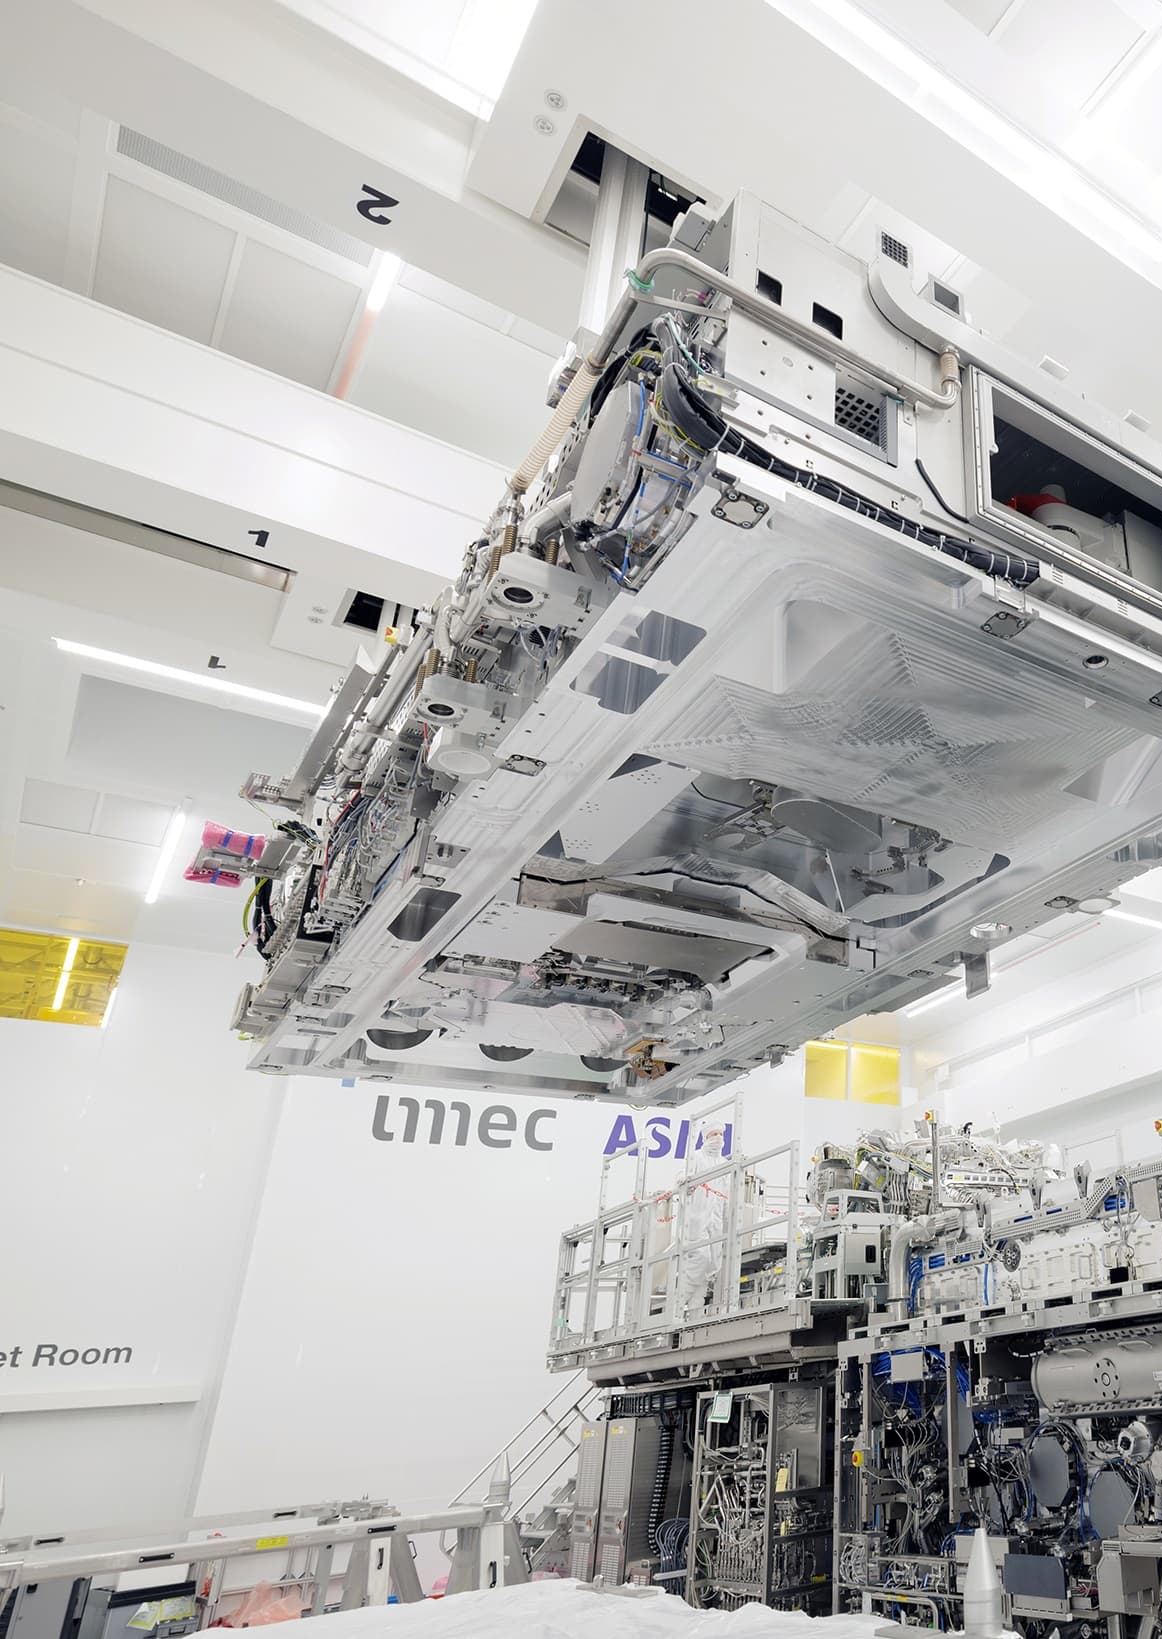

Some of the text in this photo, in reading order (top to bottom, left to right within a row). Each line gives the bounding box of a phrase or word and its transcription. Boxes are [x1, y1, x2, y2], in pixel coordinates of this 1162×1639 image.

[357, 183, 400, 226] 2
[247, 529, 270, 548] 1
[371, 1094, 558, 1152] imec
[31, 1343, 133, 1367] Room
